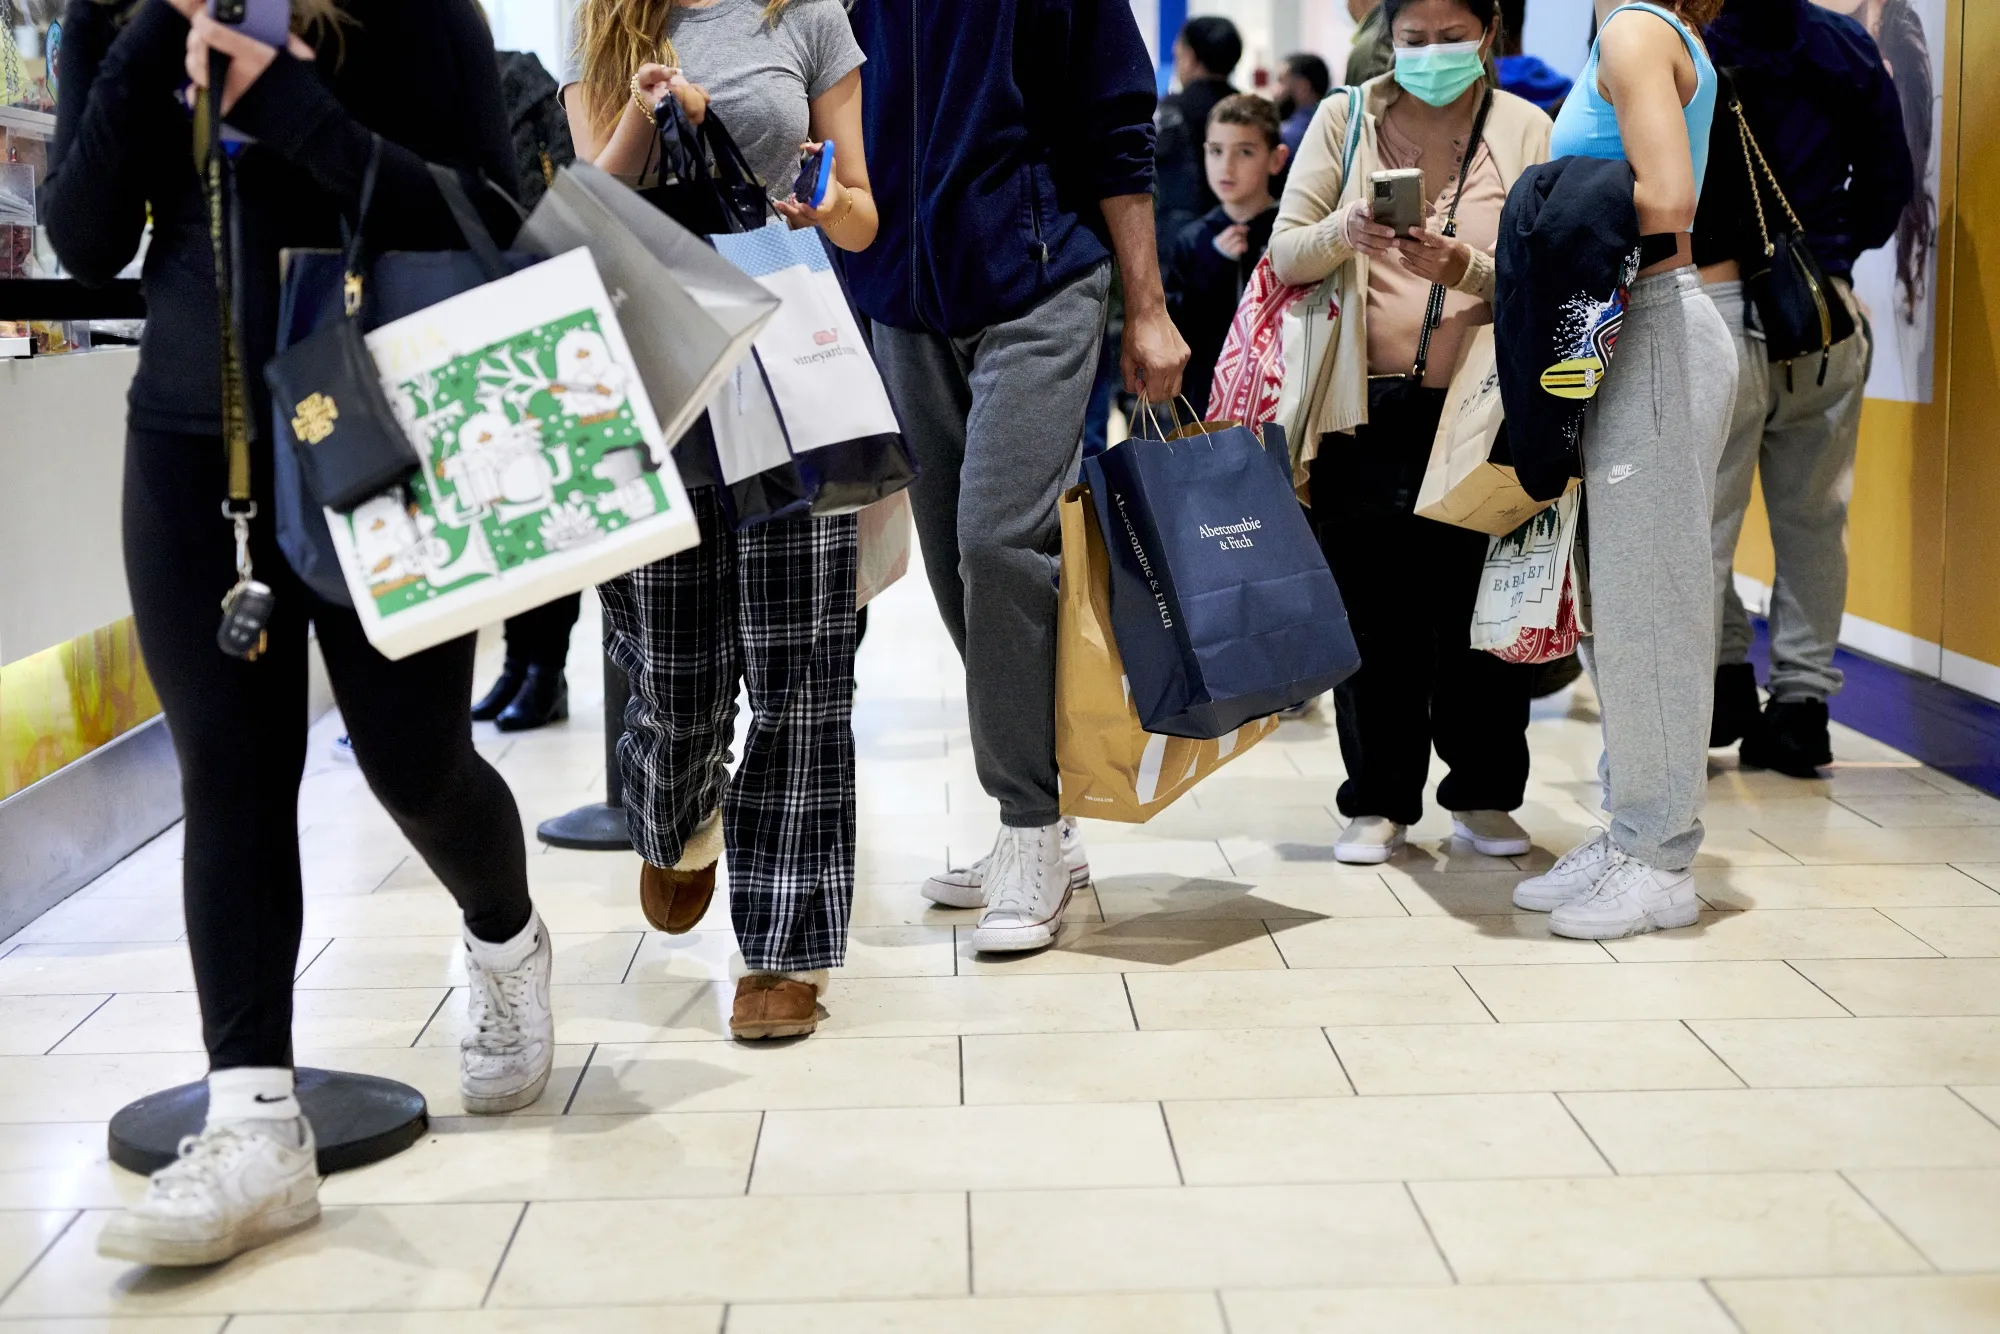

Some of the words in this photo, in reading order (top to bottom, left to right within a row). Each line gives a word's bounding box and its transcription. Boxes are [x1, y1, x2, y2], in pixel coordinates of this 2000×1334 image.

[793, 344, 843, 365] vineyard
[1233, 346, 1261, 417] ERICAN
[1611, 464, 1633, 476] NIKE
[1199, 516, 1262, 539] Abercrombie
[1113, 493, 1154, 577] Abercrombie
[1150, 579, 1159, 591] &
[1219, 540, 1229, 550] &
[1226, 534, 1254, 549] Fitch
